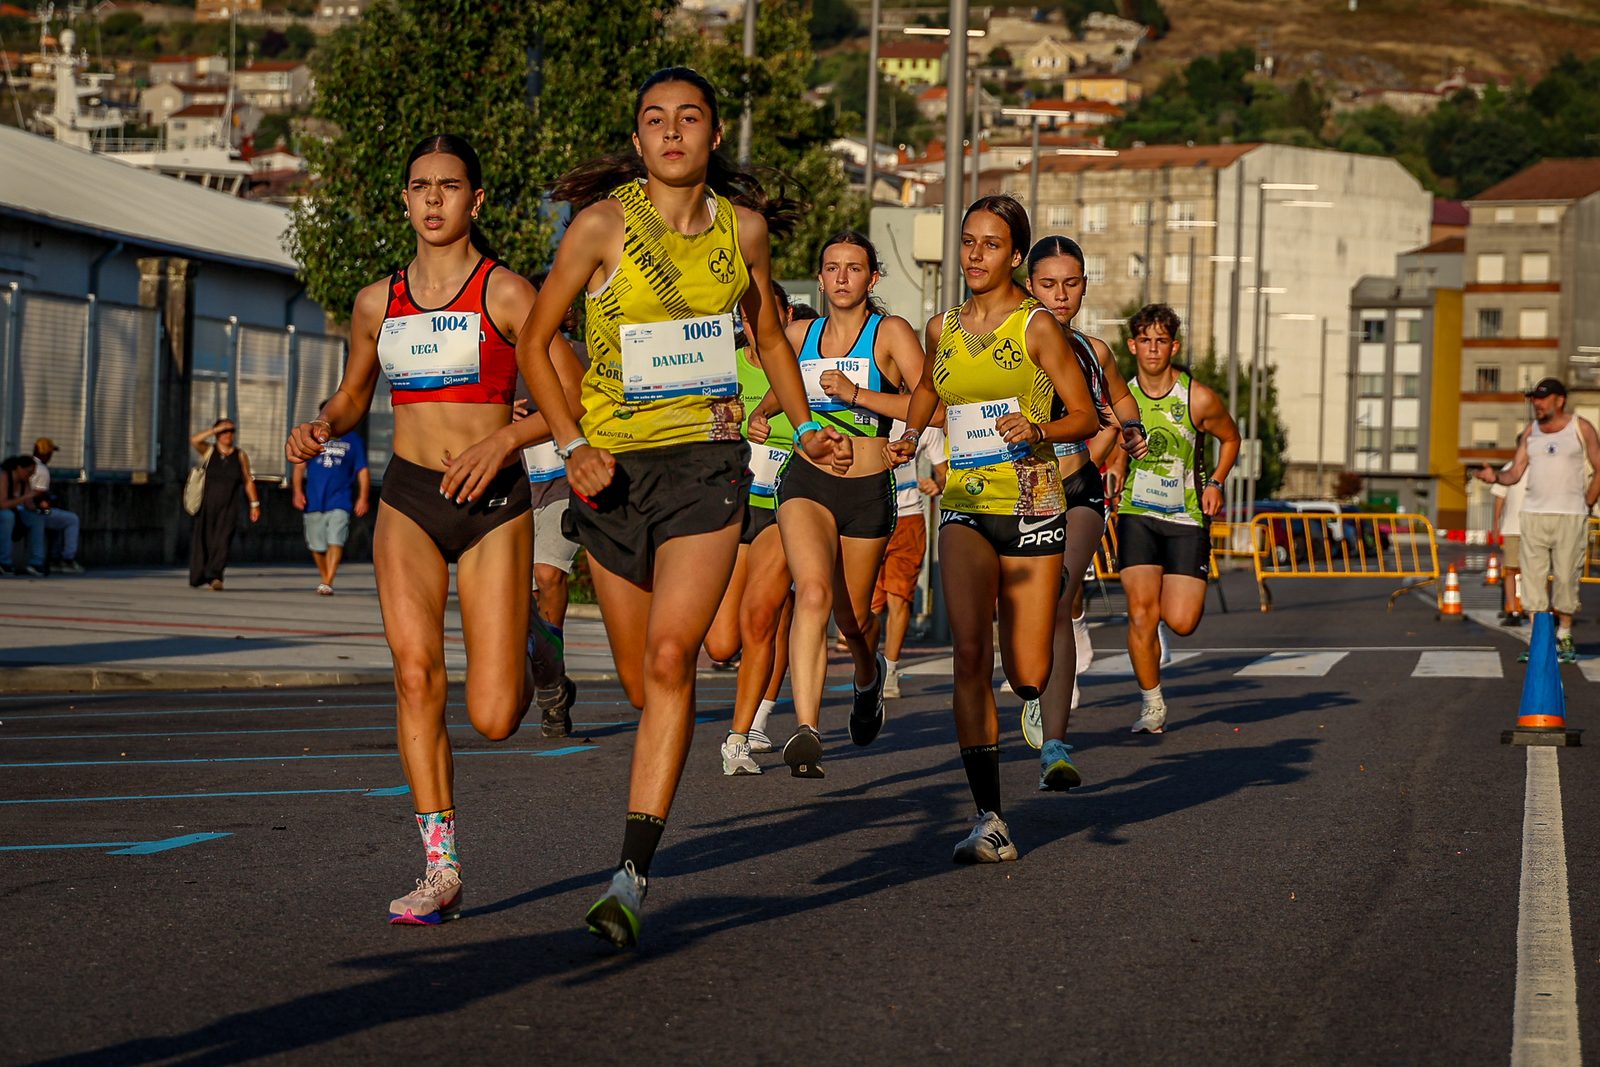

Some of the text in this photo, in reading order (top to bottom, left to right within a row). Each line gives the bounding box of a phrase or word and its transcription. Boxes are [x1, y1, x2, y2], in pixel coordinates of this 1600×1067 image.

[431, 315, 468, 333] 1004
[682, 320, 722, 341] 1005
[411, 343, 438, 355] VEGA
[652, 351, 704, 368] DANIELA
[835, 361, 859, 371] 1195
[980, 402, 1011, 420] 1202
[966, 428, 995, 440] PAULA
[1160, 478, 1178, 488] 1007
[1145, 487, 1168, 498] CARLOS
[1017, 527, 1065, 548] PRO
